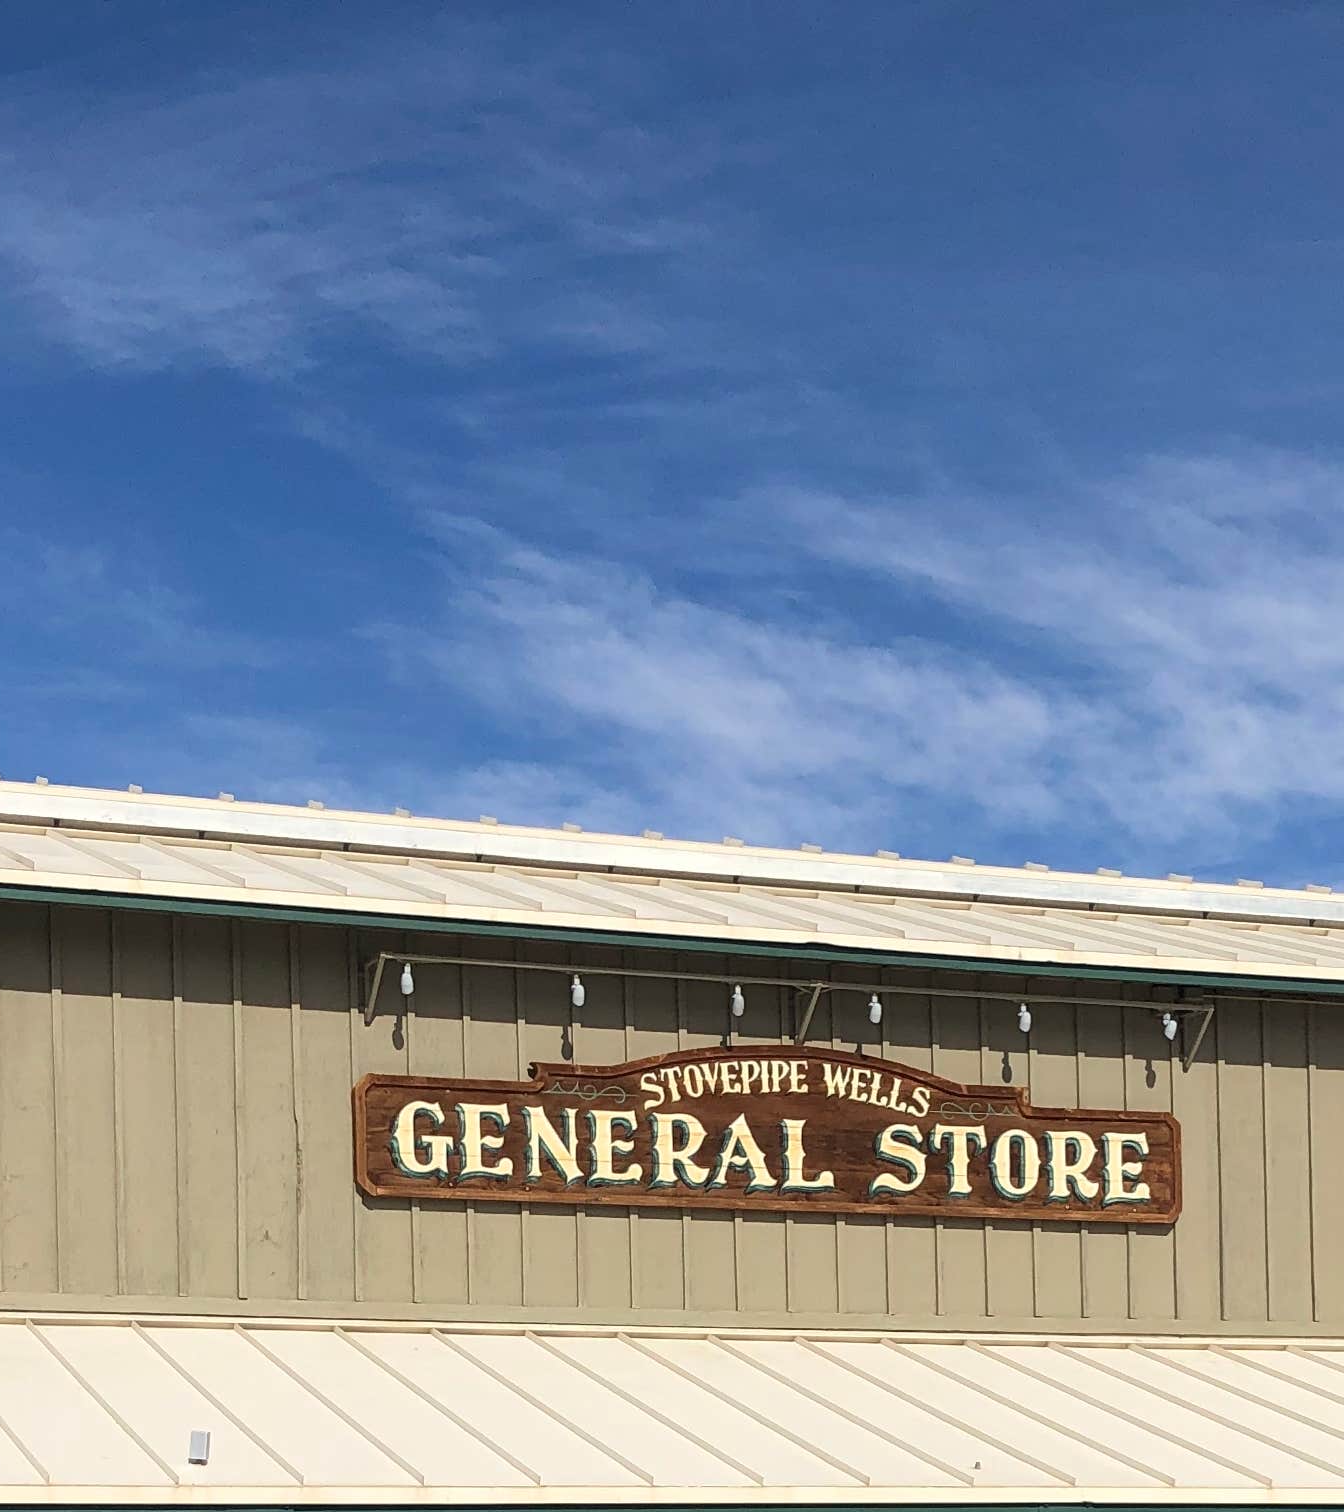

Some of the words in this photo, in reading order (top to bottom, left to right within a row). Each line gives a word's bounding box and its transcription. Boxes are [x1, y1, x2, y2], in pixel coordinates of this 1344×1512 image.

[640, 1059, 809, 1110] STOVEPIPE
[822, 1063, 931, 1116] WELLS
[391, 1100, 835, 1193] GENERAL
[869, 1122, 1151, 1208] STORE
